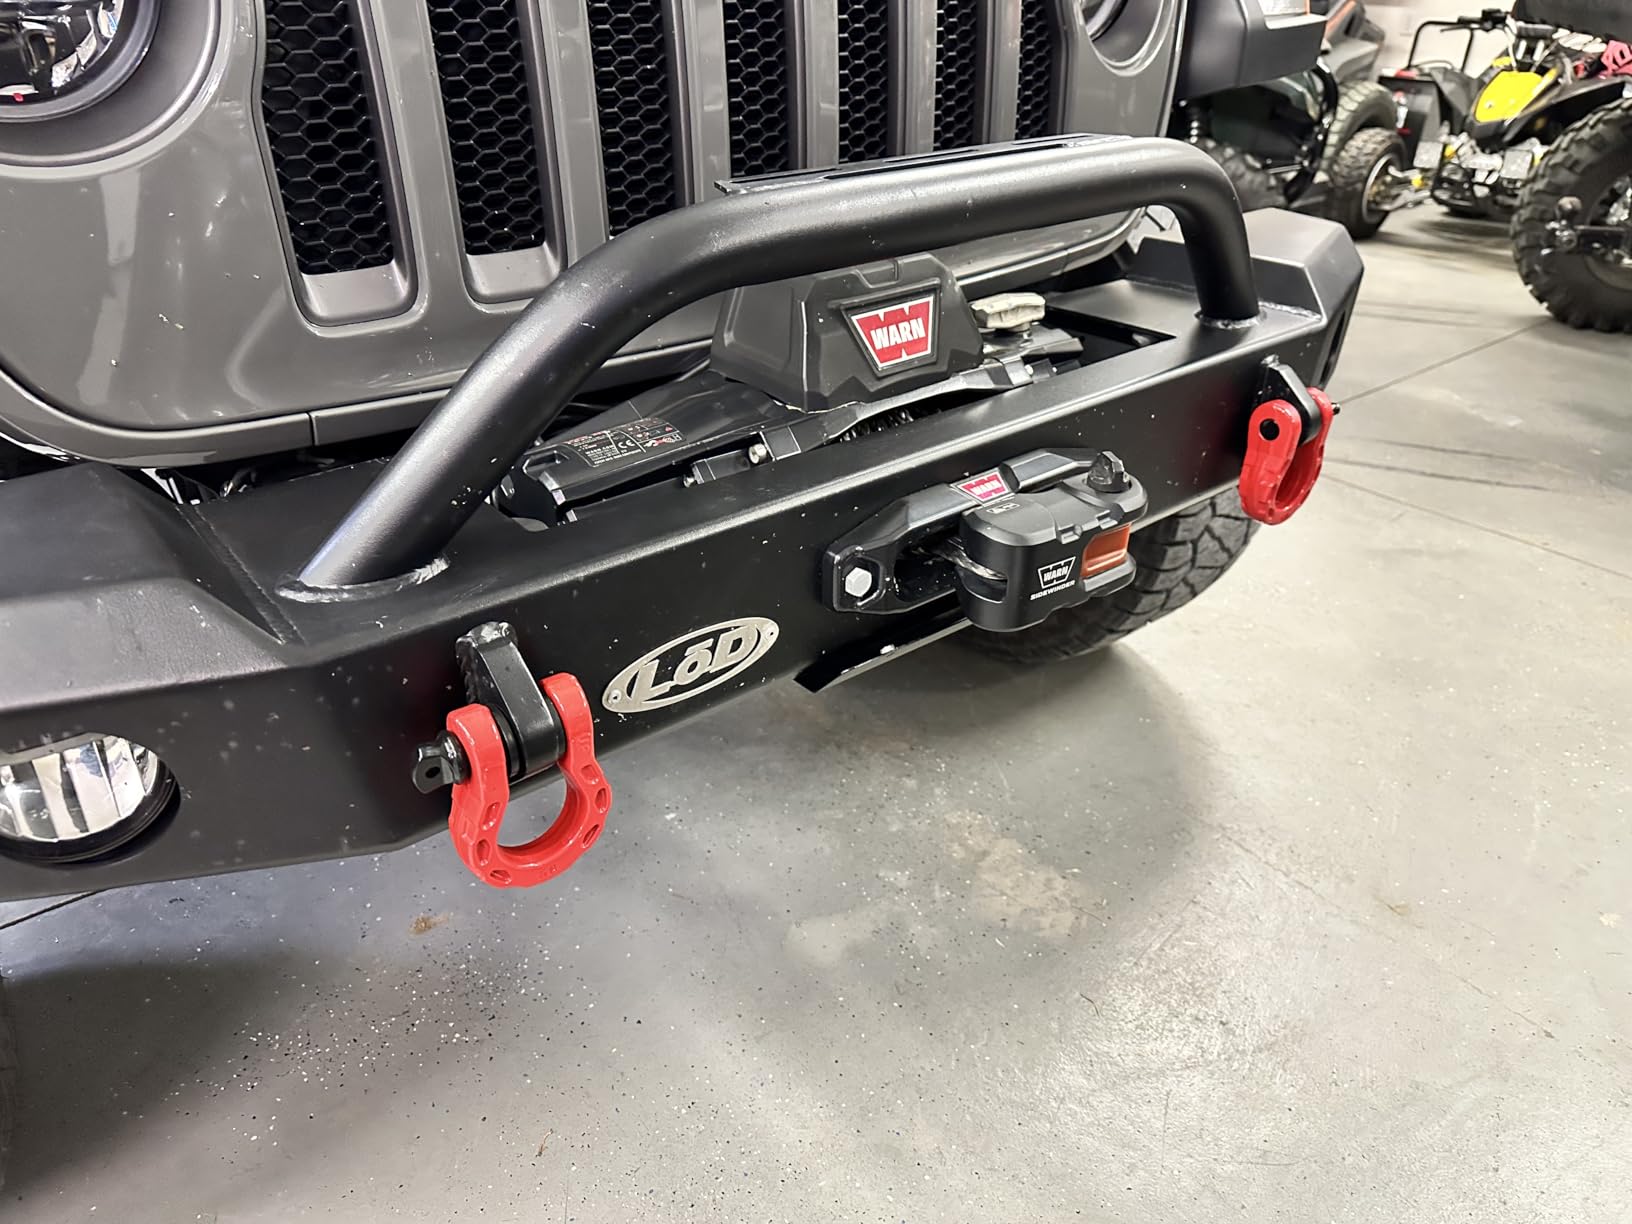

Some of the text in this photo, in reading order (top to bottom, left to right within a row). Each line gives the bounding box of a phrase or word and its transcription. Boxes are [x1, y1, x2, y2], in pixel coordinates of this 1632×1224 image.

[869, 317, 926, 350] WARN
[1043, 565, 1069, 582] WARN
[1030, 579, 1076, 600] SIDEWINDER
